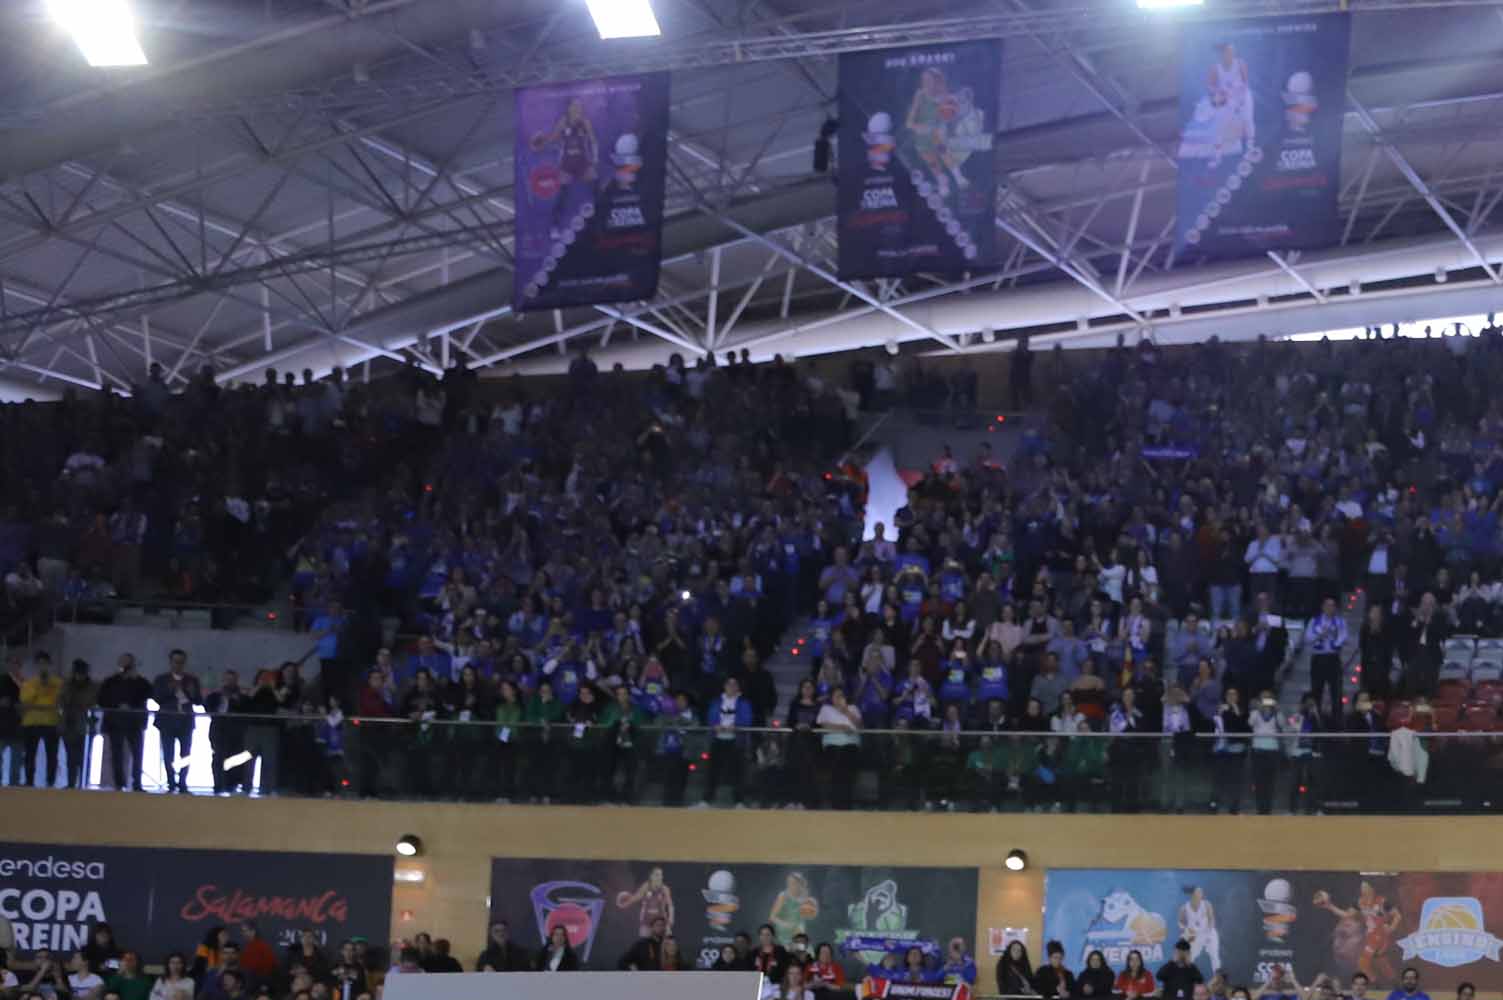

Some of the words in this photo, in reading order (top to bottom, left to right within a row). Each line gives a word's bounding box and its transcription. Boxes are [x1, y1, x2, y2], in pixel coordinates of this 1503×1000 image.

[0, 855, 105, 879] endesa
[0, 888, 106, 922] COPA
[11, 922, 89, 951] REIN
